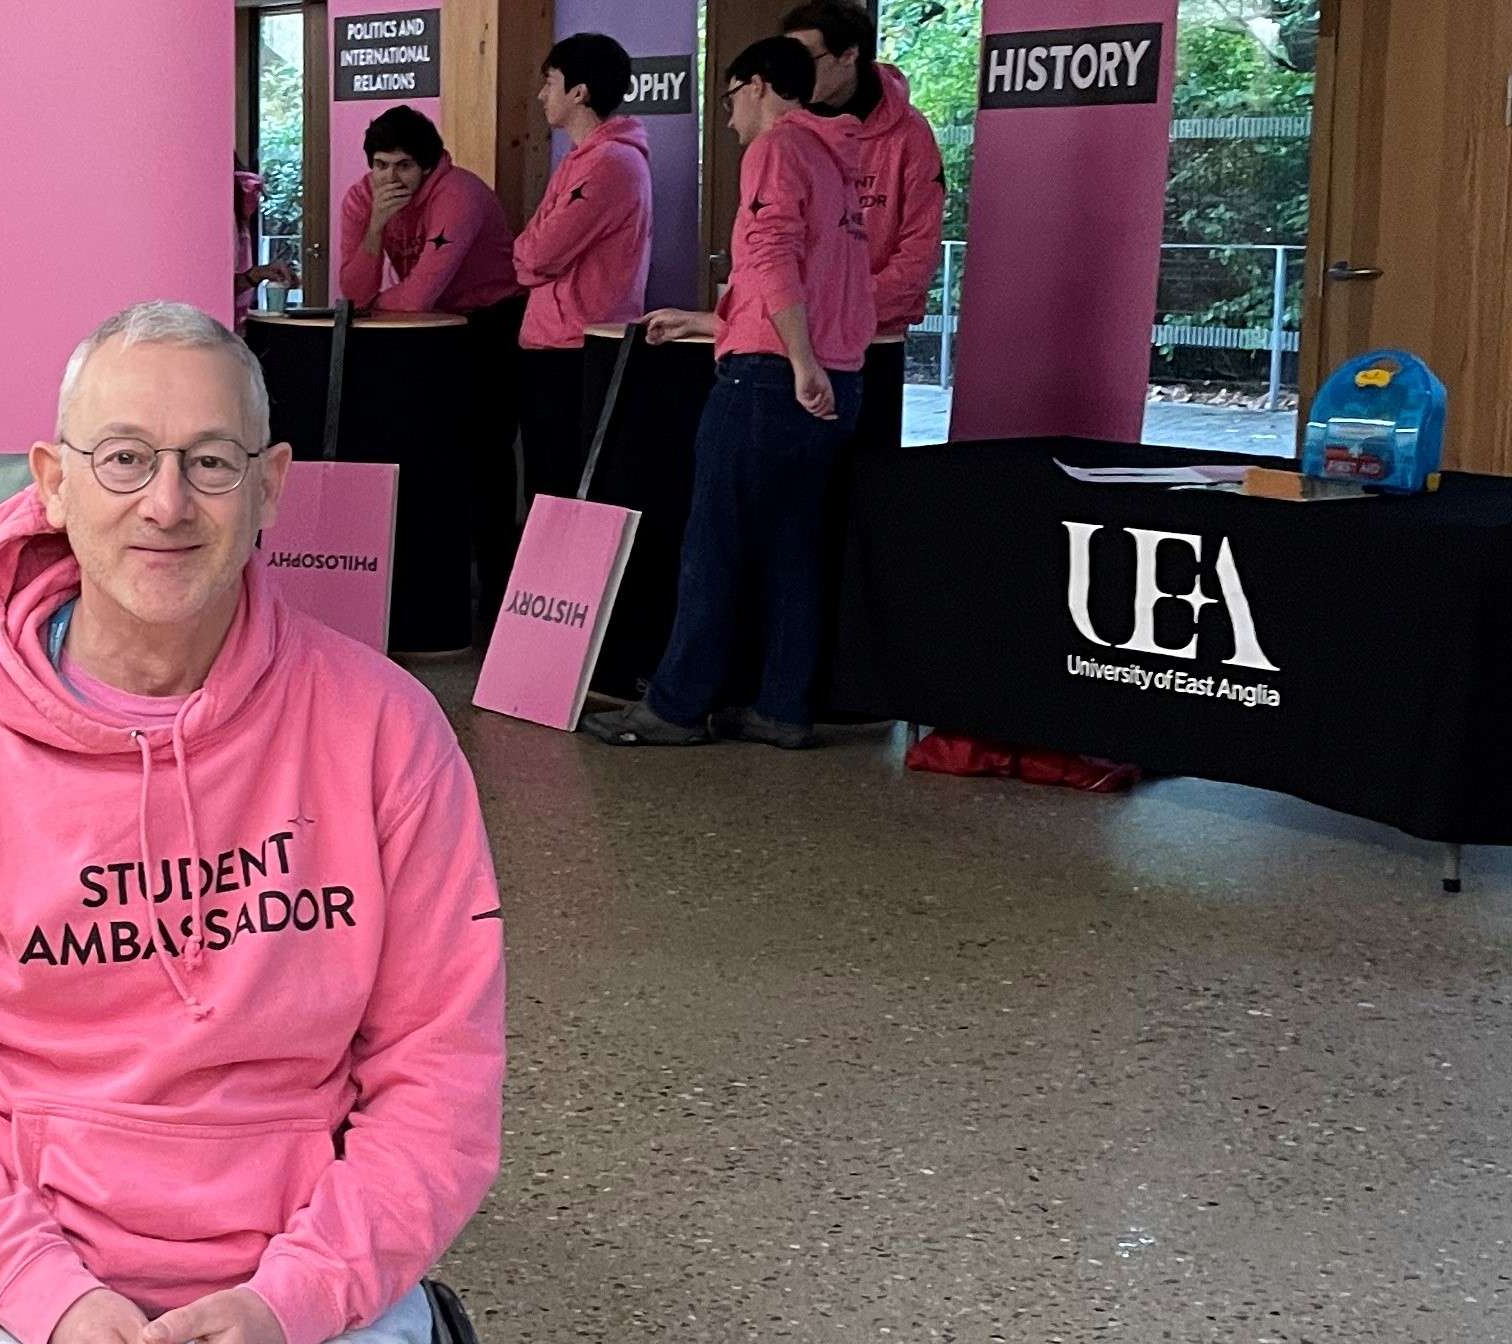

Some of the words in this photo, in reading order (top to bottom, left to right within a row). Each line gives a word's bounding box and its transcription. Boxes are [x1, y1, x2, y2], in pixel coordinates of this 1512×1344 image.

[347, 20, 397, 40] POLITICS
[398, 18, 425, 37] AND
[340, 44, 430, 67] INTERNATIONAL
[987, 39, 1152, 93] HISTORY
[353, 72, 416, 92] RELATIONS
[623, 71, 686, 103] OPHY
[267, 551, 378, 572] PHILOSOPHY
[506, 589, 588, 629] HISTORY
[1061, 520, 1281, 672] UEA
[1067, 654, 1154, 690] University
[1154, 669, 1174, 691] of
[1174, 671, 1215, 697] East
[1216, 678, 1281, 707] Anglia
[79, 831, 293, 908] STUDENT
